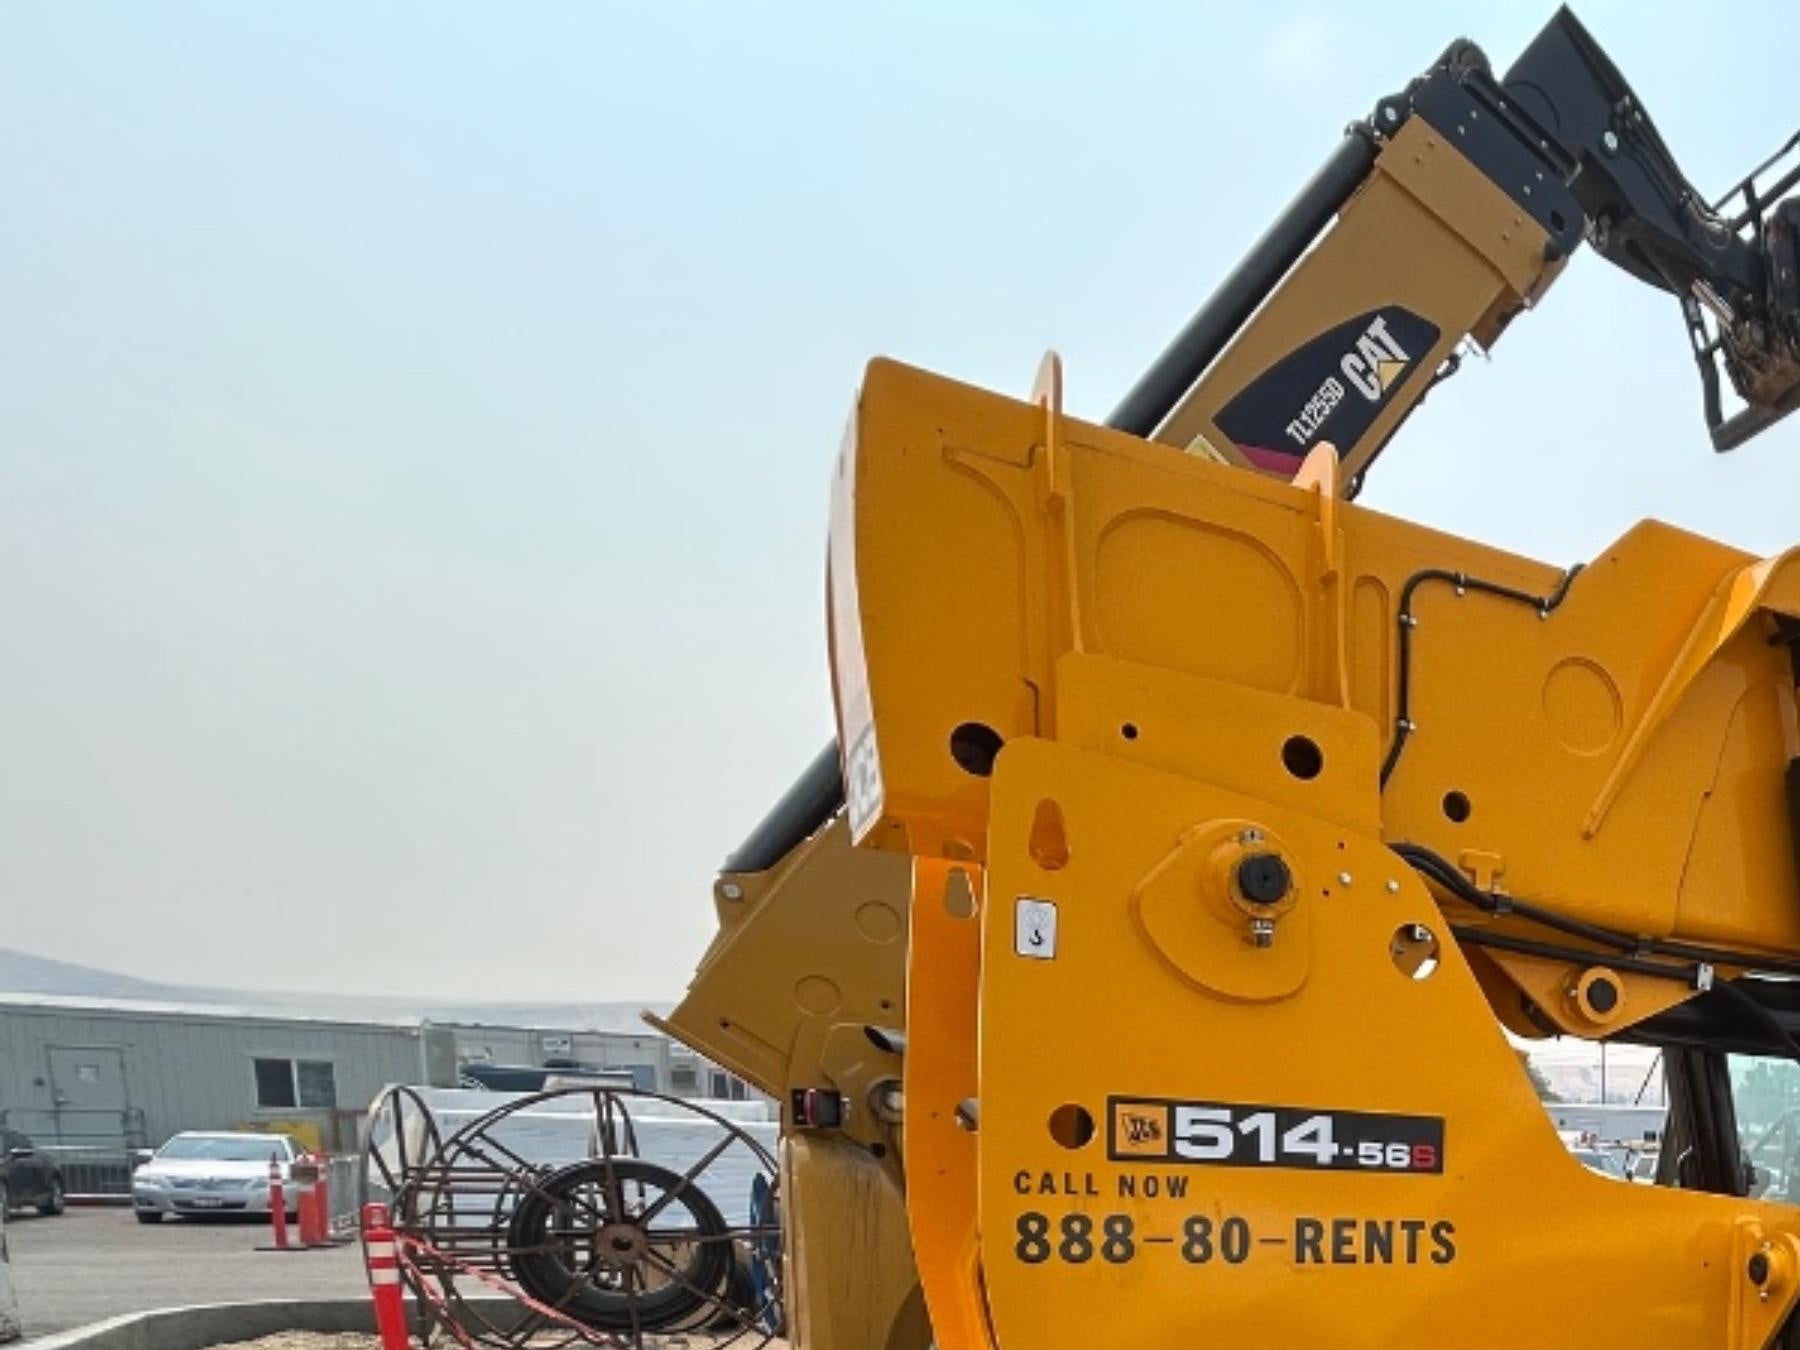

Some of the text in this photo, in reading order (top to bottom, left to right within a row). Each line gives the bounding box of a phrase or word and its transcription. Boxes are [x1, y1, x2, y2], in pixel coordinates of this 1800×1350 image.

[1340, 314, 1410, 401] CAT
[1286, 376, 1345, 444] TL1255D
[1014, 1170, 1189, 1198] CALL NOW
[1015, 1212, 1456, 1264] 888-80-RENTS
